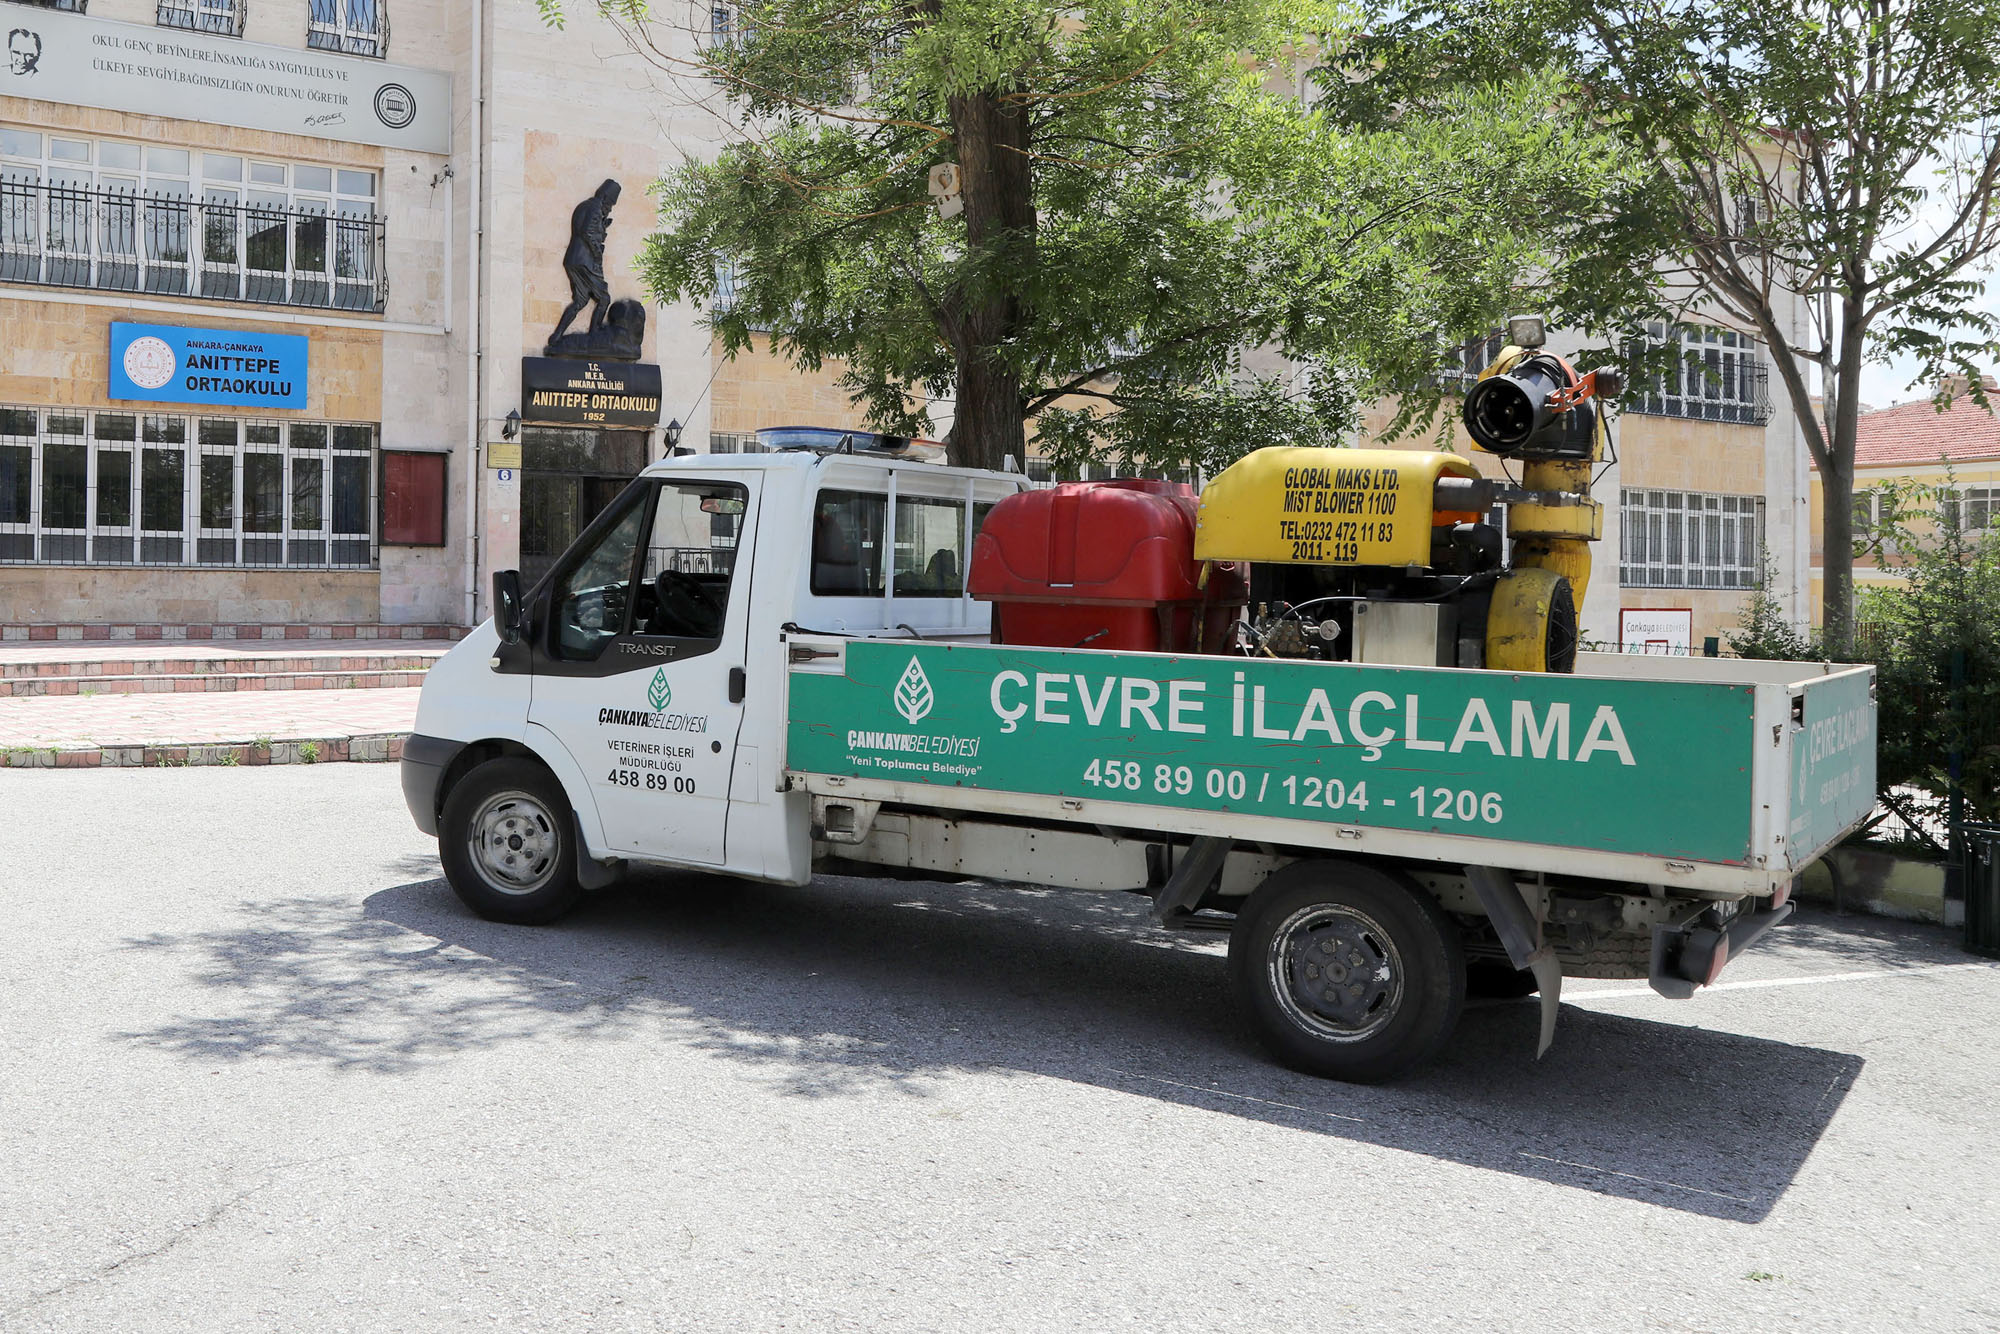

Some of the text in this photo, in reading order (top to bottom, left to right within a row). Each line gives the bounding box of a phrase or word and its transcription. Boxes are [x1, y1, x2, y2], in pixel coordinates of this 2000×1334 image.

[92, 34, 121, 48] OKUL
[124, 38, 153, 55] GENÇ
[336, 70, 349, 81] VE
[92, 57, 135, 76] ÜLKEYE
[256, 82, 305, 100] ONURUNU
[307, 88, 349, 106] ÖĞRETİR
[186, 340, 264, 353] ANKARA-ÇANKAYA
[186, 354, 280, 374] ANITTEPE
[588, 362, 601, 372] T.C.
[186, 375, 292, 397] ORTAOKULU
[567, 379, 624, 391] ANKARA VALİLİĞİ
[584, 371, 606, 381] M.E.B.
[532, 391, 657, 412] ANITTEPE ORTAOKULU
[583, 412, 605, 421] 1952
[501, 471, 509, 480] 6
[1285, 467, 1400, 490] GLOBAL MAKS LTD.
[1314, 491, 1364, 514] BLOWER
[1368, 492, 1396, 515] 1100
[1335, 521, 1357, 541] 472
[1361, 522, 1374, 542] 11
[1378, 522, 1393, 543] 83
[1292, 541, 1323, 560] 2011
[1334, 542, 1358, 562] 119
[619, 643, 676, 656] TRANSIT
[990, 670, 1637, 766] ÇEVRE İLAÇLAMA
[608, 740, 694, 759] VETERİNER İŞLERİ
[1809, 716, 1837, 776] ÇEVRE
[620, 757, 682, 772] MÜDÜRLÜĞÜ
[874, 757, 930, 772] Toplumcu
[608, 769, 696, 794] 458 89 00
[1083, 758, 1142, 790] 458
[1154, 764, 1193, 795] 89
[1206, 768, 1246, 800] 00
[1282, 775, 1369, 812] 1204
[1409, 786, 1503, 823] 1206
